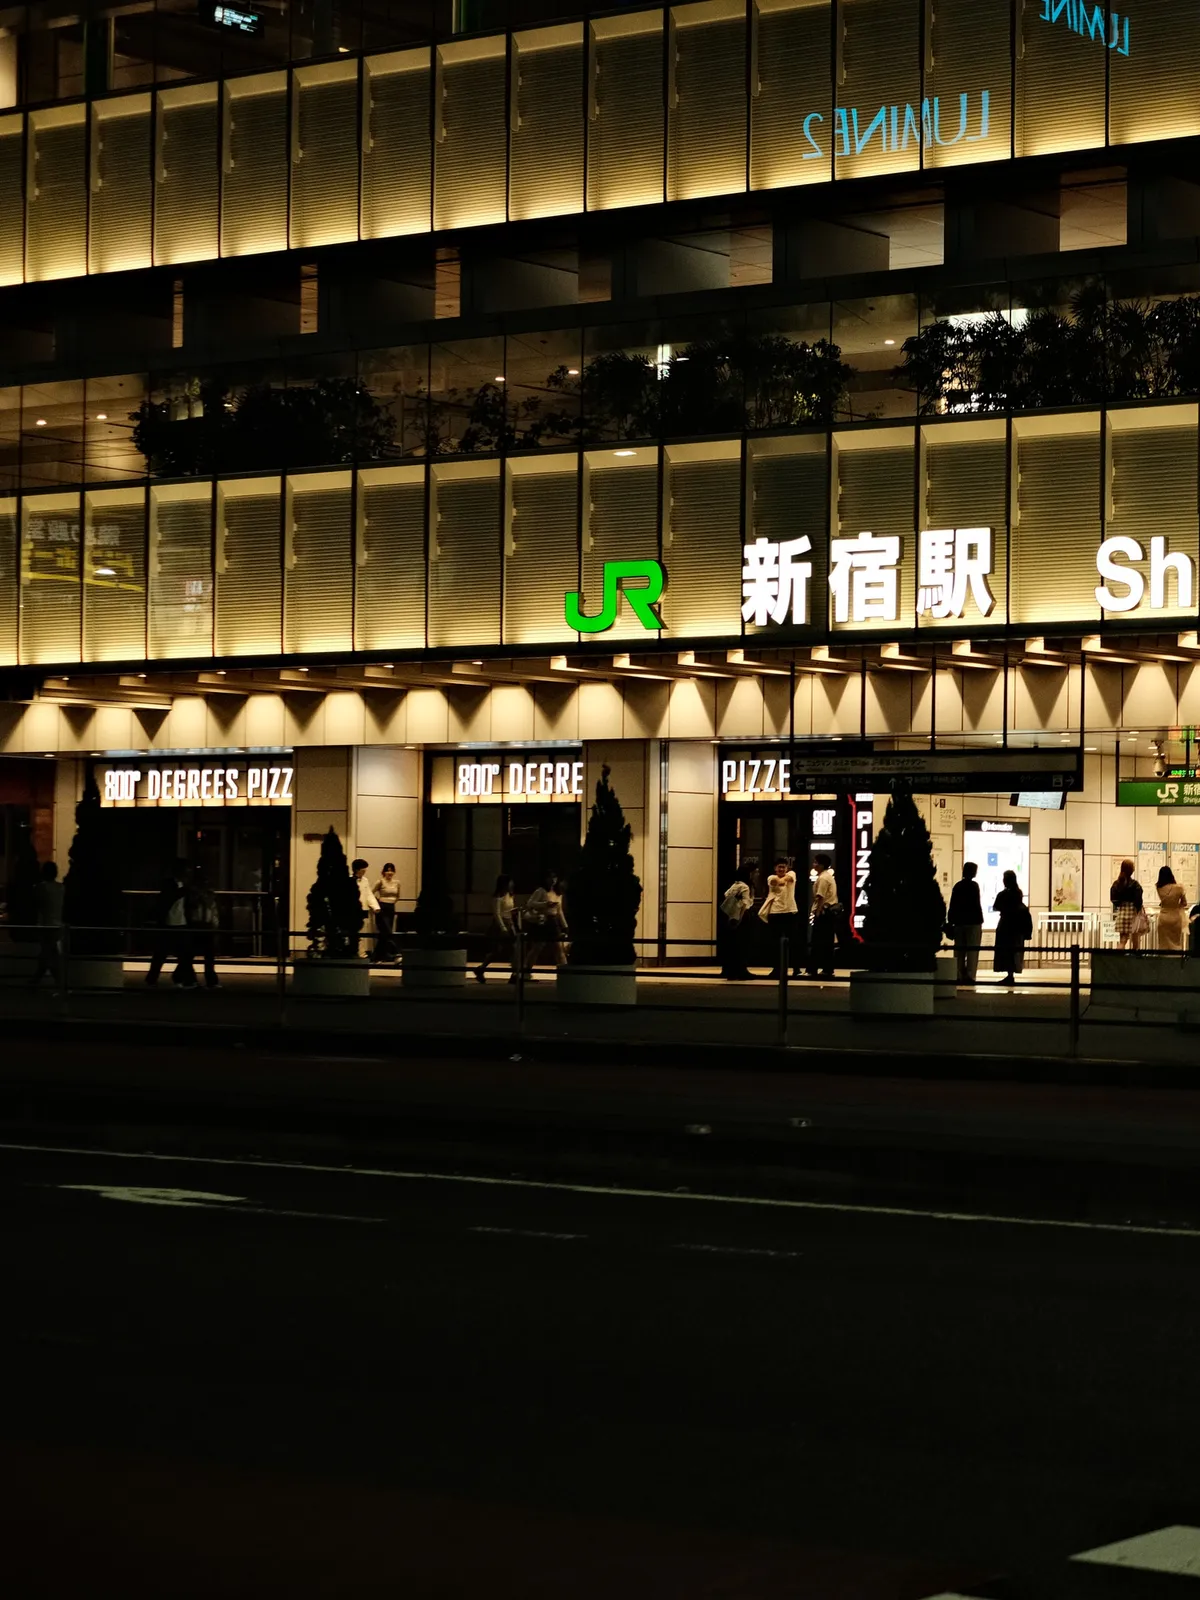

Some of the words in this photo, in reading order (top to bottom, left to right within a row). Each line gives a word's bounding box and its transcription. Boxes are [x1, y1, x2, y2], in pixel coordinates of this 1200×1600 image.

[741, 527, 994, 628] 新宿駅
[564, 560, 665, 634] JR
[148, 769, 239, 800] DEGREES
[247, 768, 294, 799] PIZZ
[509, 762, 584, 796] DEGRE
[722, 759, 791, 793] PIZZE
[1157, 783, 1179, 798] JR
[1141, 842, 1164, 850] NOTICE
[1174, 843, 1196, 851] NOTICE
